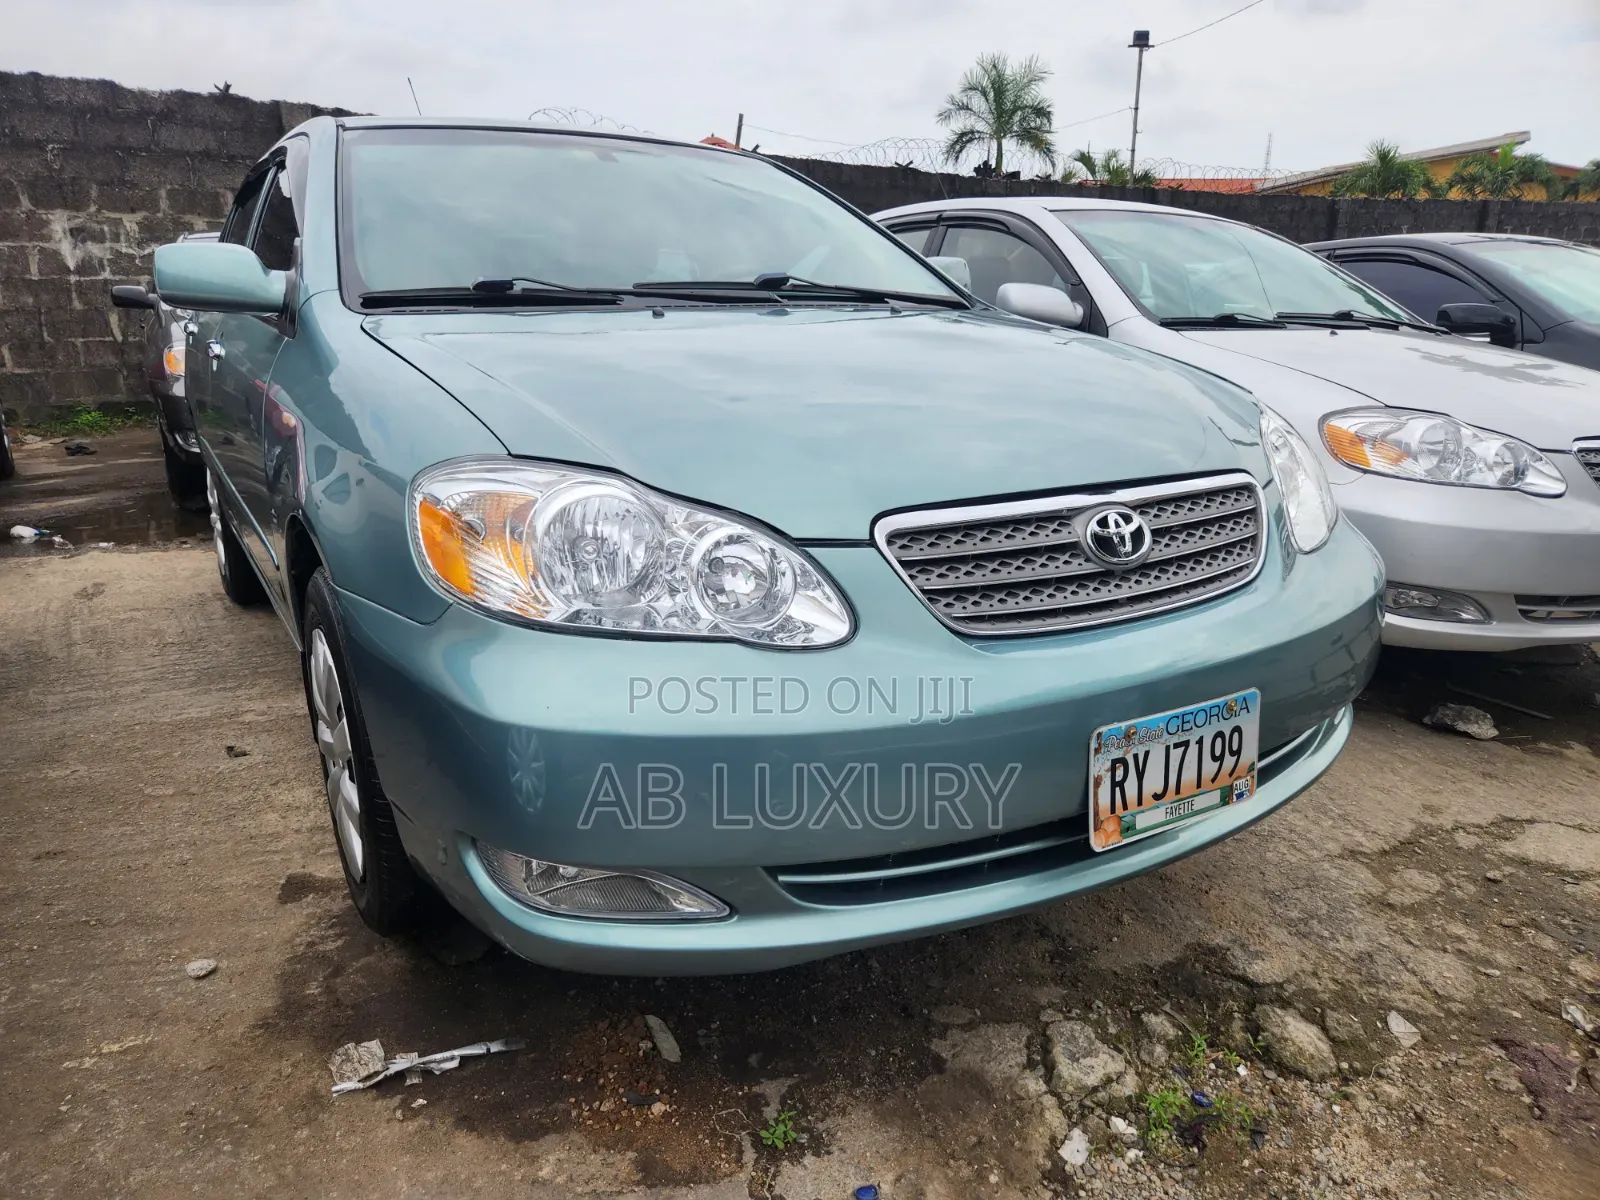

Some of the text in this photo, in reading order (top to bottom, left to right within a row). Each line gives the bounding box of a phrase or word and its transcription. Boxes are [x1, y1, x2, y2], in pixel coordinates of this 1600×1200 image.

[1165, 696, 1251, 736] GEORGIA
[1138, 726, 1164, 744] State
[1110, 725, 1244, 815] RYJ7199
[1234, 779, 1249, 793] AUG
[1165, 799, 1195, 820] FAYETTE
